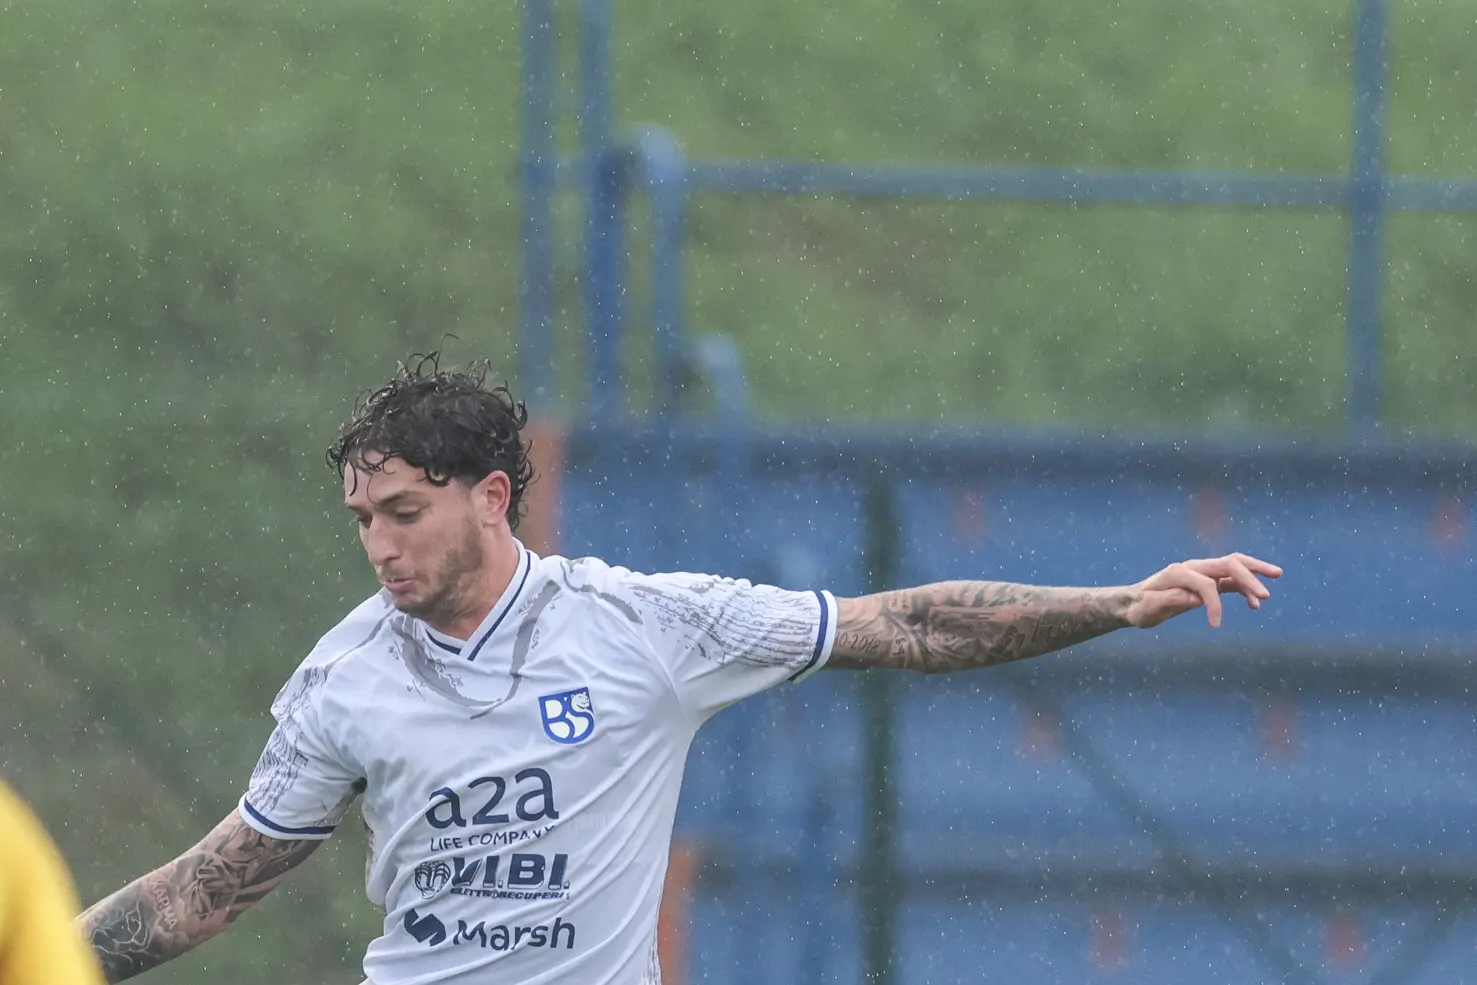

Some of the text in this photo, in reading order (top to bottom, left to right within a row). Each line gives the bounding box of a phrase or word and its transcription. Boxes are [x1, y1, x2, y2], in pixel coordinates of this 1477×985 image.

[424, 767, 560, 829] a2a
[429, 837, 464, 852] LIFE
[452, 916, 576, 951] Marsh
